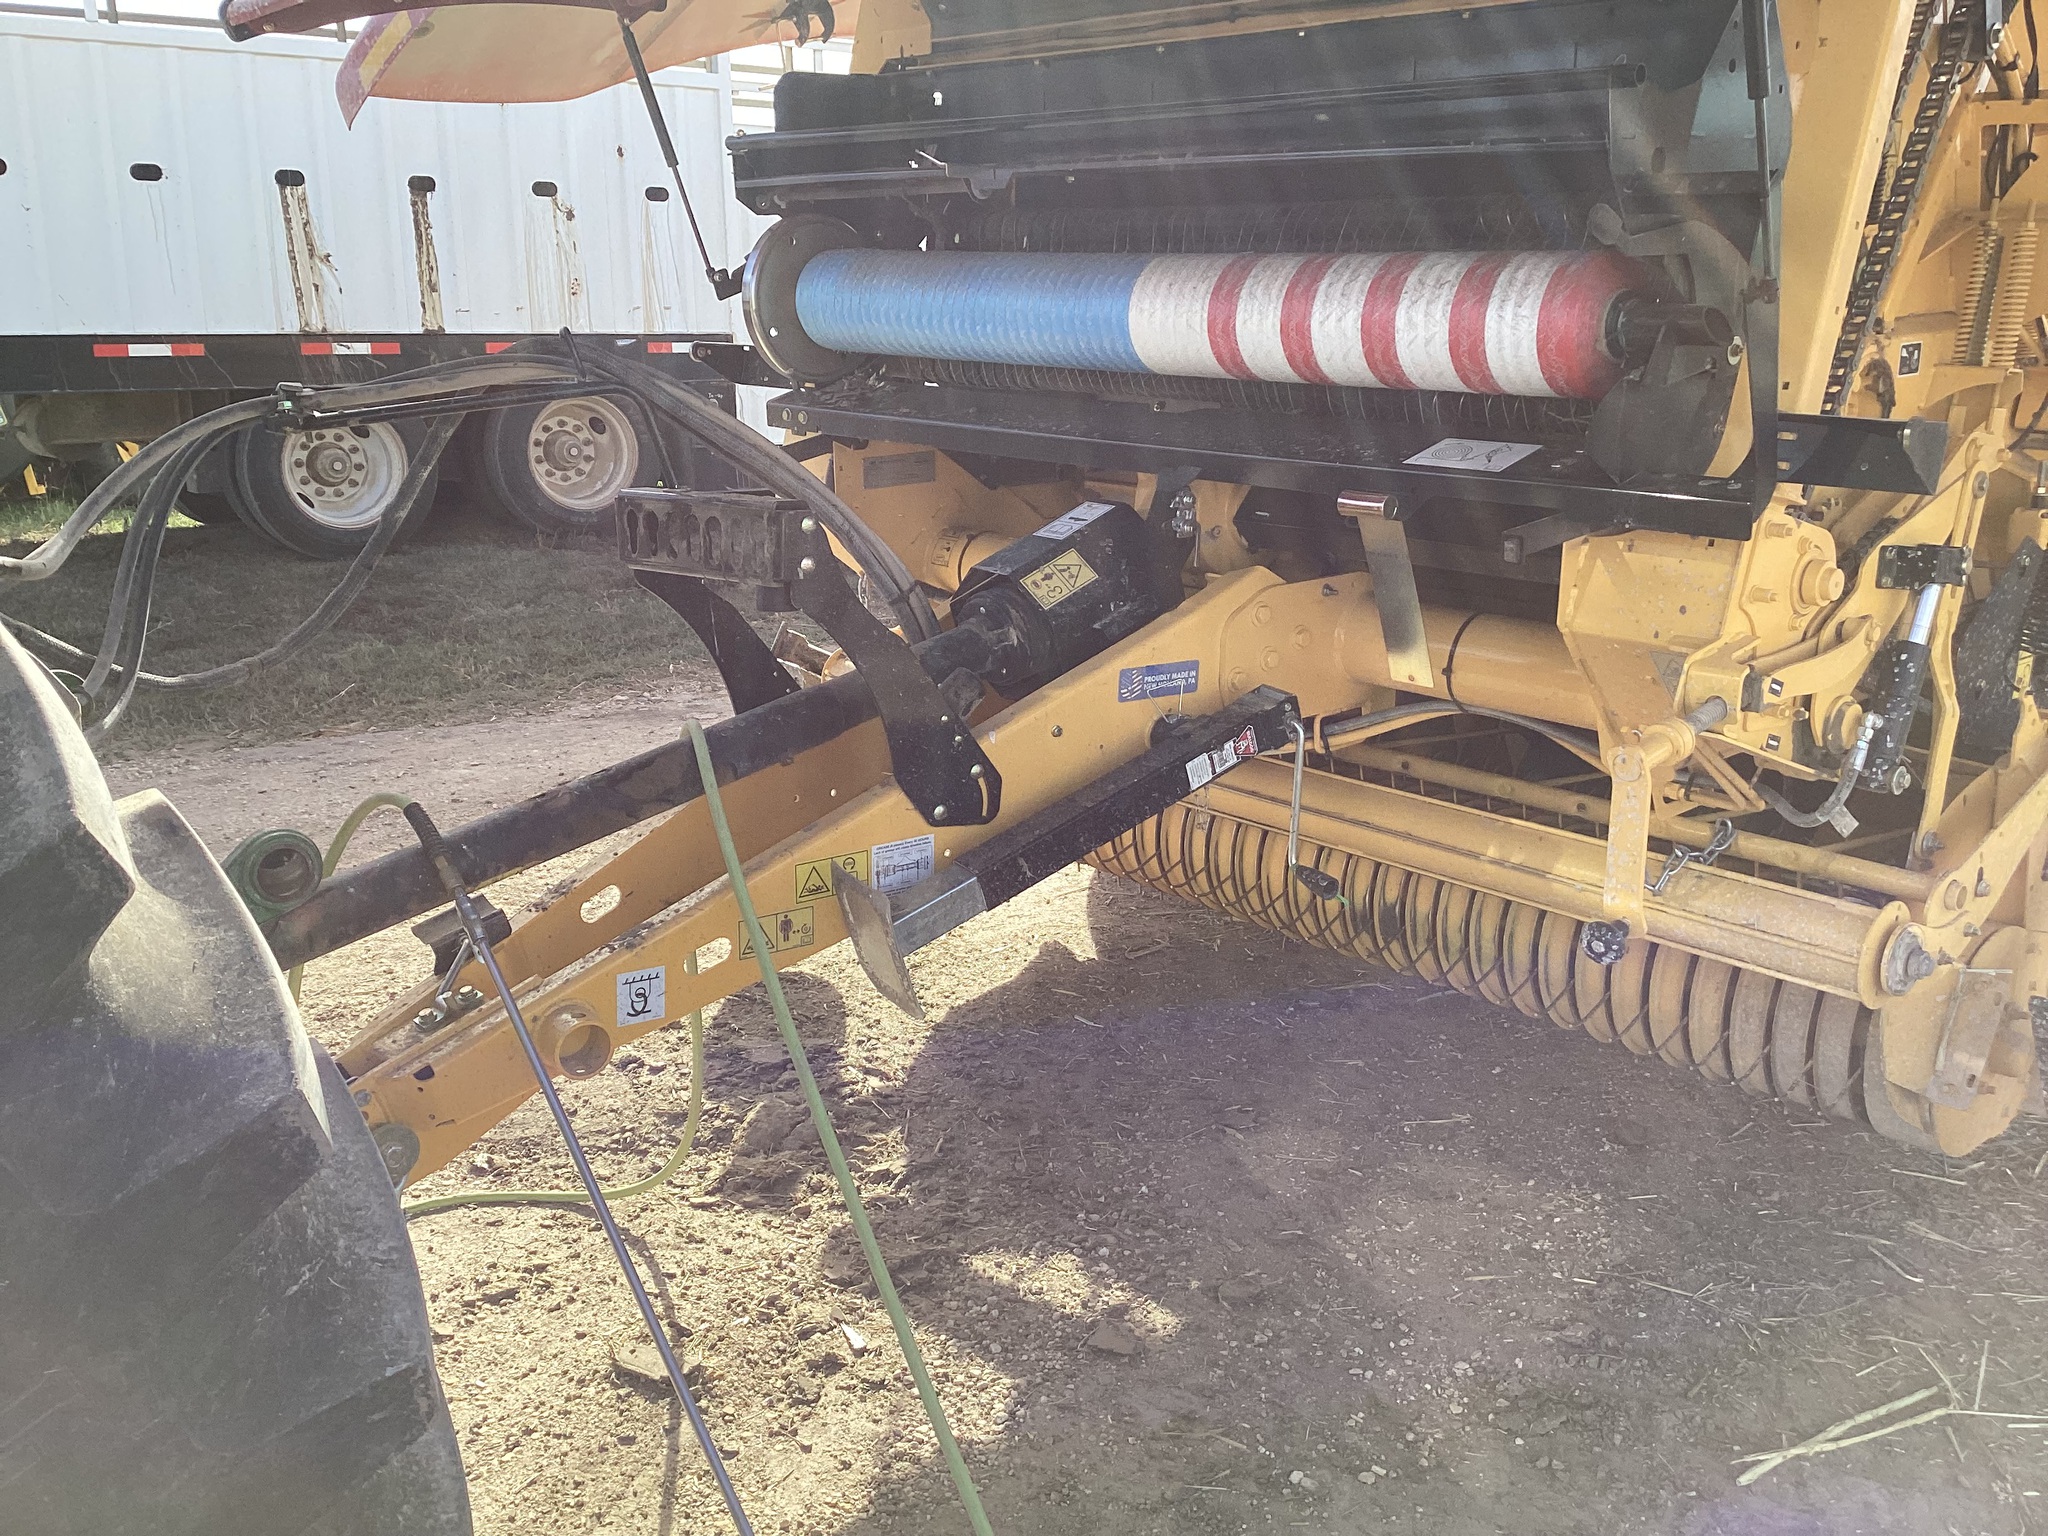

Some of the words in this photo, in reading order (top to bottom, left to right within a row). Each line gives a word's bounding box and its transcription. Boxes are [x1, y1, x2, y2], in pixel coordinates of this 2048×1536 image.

[1144, 673, 1170, 683] PROUDLY
[1172, 670, 1189, 680] MADE
[1189, 670, 1197, 678] IN
[1188, 677, 1196, 685] PA
